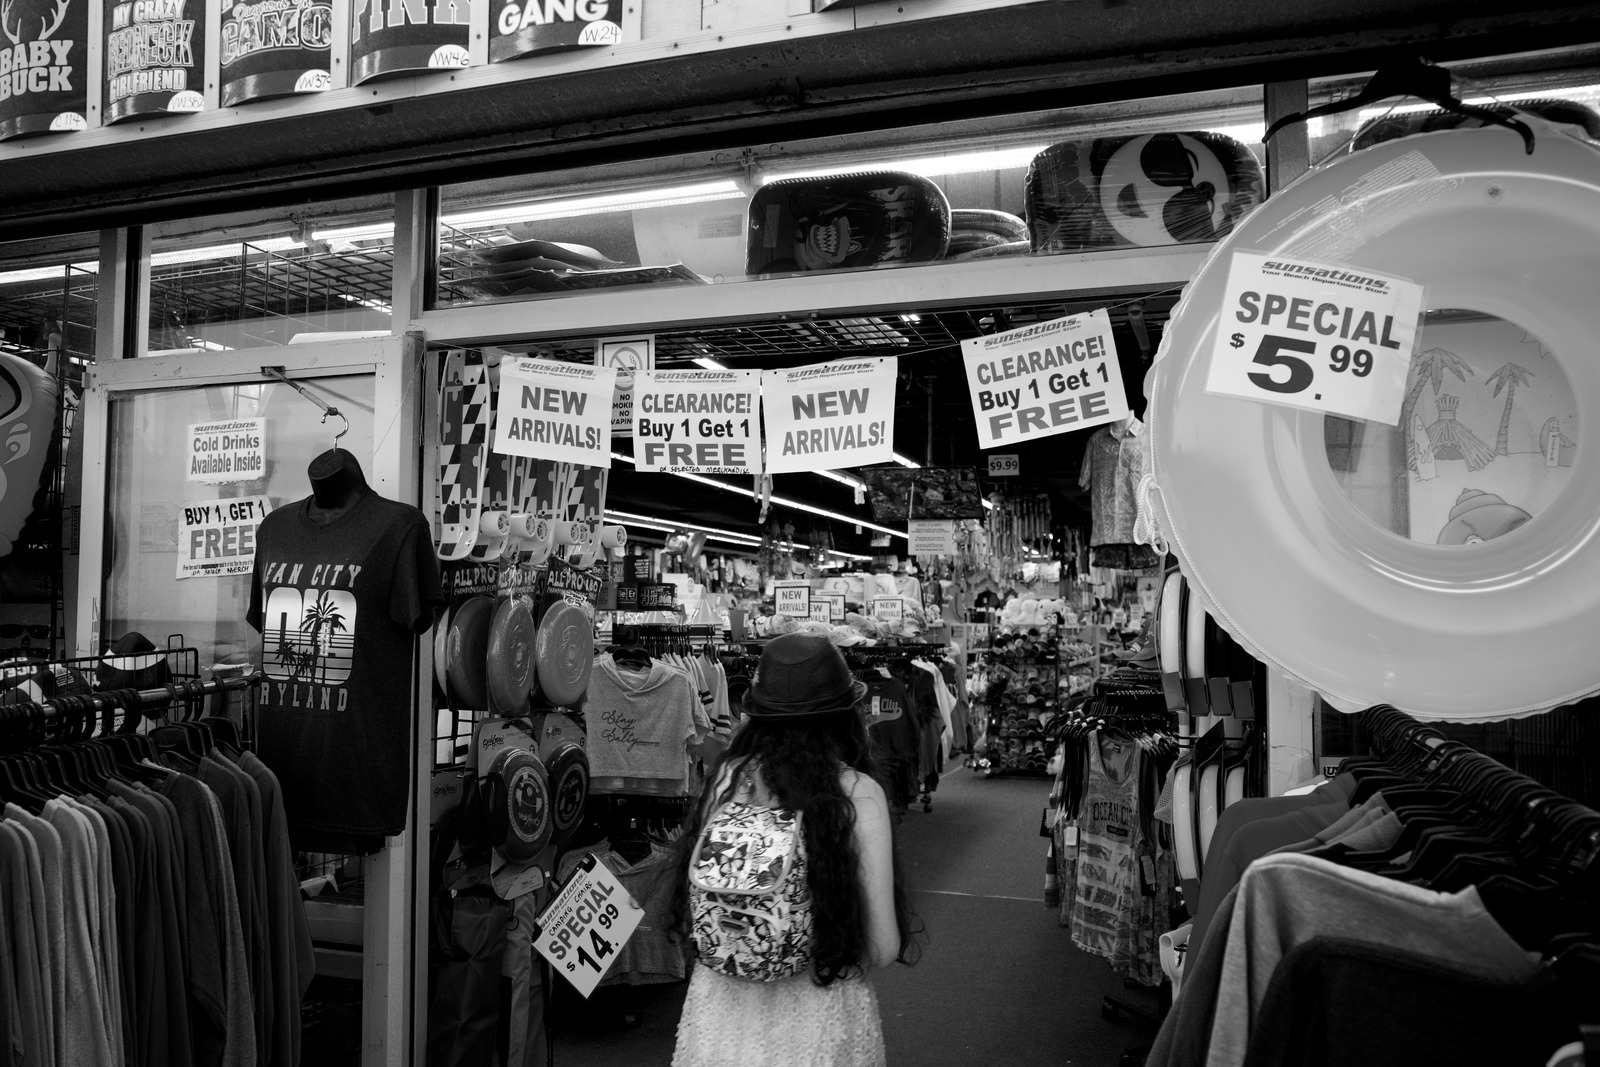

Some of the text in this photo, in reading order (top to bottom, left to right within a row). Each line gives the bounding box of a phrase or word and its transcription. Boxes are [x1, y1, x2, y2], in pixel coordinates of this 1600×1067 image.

[113, 0, 186, 30] MY CRAZY
[498, 0, 609, 36] GANG
[221, 6, 332, 66] CAMO
[0, 40, 73, 76] BABY
[108, 20, 195, 80] REDNECK
[0, 66, 73, 101] BUCK
[110, 68, 186, 104] GIRLFRIEND
[1262, 261, 1387, 289] sunsations
[1262, 269, 1389, 295] Your Beach Department Store
[984, 317, 1077, 347] sunsations
[1236, 290, 1401, 350] SPECIAL
[518, 362, 594, 376] sunsations
[786, 362, 872, 379] sunsations
[977, 335, 1106, 385] CLEARANCE!
[653, 371, 735, 380] sunsations
[979, 362, 1110, 411] Buy 1 Get 1
[521, 385, 587, 416] NEW
[641, 393, 752, 414] CLEARANCE!
[792, 388, 869, 420] NEW
[194, 421, 256, 432] sunsations
[988, 391, 1110, 440] FREE
[193, 434, 260, 452] Cold Drinks
[508, 417, 601, 450] ARRIVALS!
[639, 418, 750, 441] Buy 1 Get 1
[783, 420, 886, 456] ARRIVALS!
[191, 451, 261, 475] Available Inside
[645, 443, 747, 466] FREE
[990, 460, 1018, 471] $9.99
[184, 506, 210, 526] BUY
[229, 501, 254, 521] GET
[258, 499, 266, 518] 1
[311, 564, 362, 588] CITY
[454, 568, 473, 588] ALL
[474, 566, 496, 585] PRO
[565, 571, 584, 590] PRO
[779, 602, 807, 612] ARRIVALS!
[781, 590, 802, 600] NEW
[601, 710, 637, 731] Stay
[602, 728, 648, 752] Salty
[1093, 802, 1119, 823] OCEAN
[548, 906, 573, 936] CAMPING
[548, 881, 615, 961] SPECIAL
